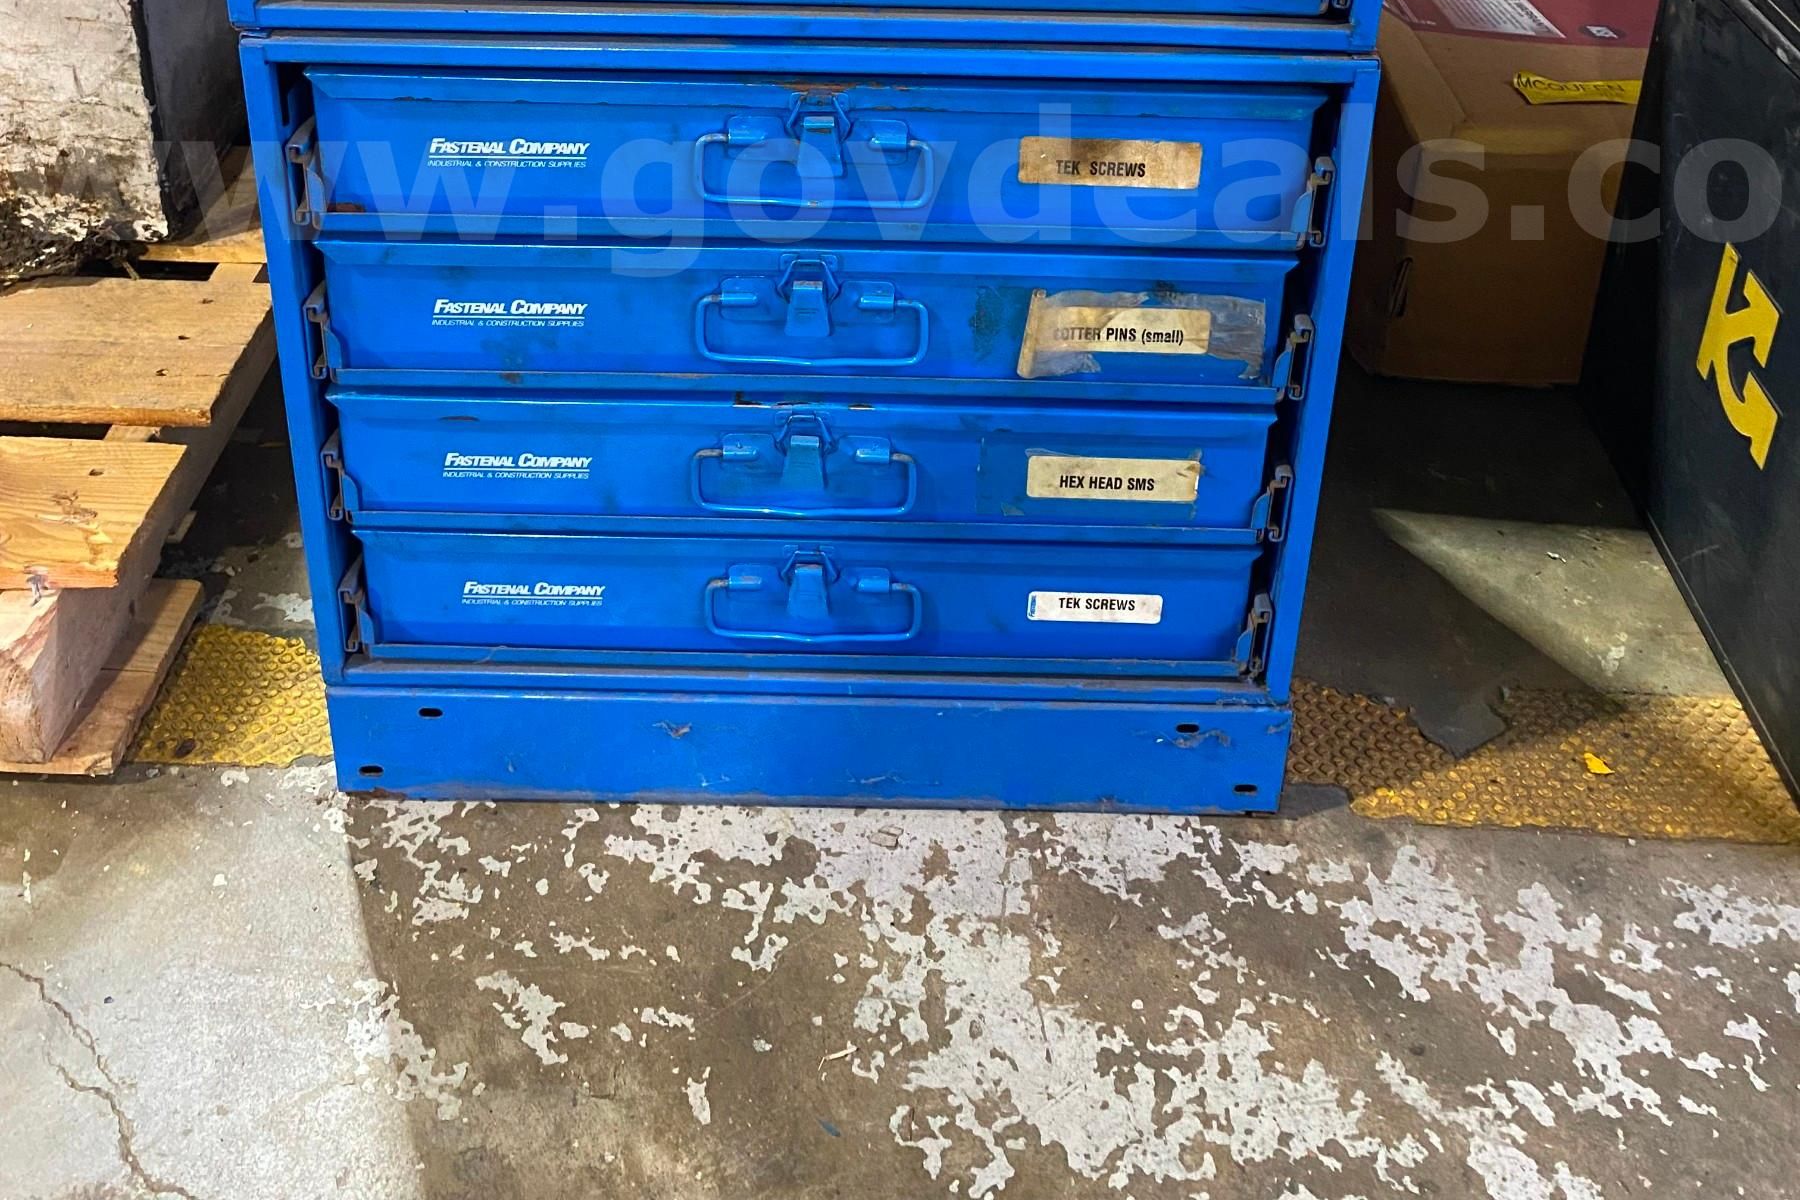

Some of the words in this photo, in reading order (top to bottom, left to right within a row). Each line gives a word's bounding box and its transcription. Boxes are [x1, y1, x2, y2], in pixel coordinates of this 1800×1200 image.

[429, 138, 507, 154] FASTENAL
[508, 138, 590, 154] COMPANY
[1055, 160, 1080, 176] TEK
[1089, 161, 1146, 177] SCREWS
[433, 299, 508, 314] FASTENAL
[510, 300, 588, 315] COMPANY
[1106, 328, 1137, 342] PINS
[1141, 328, 1184, 346] (small)
[444, 453, 515, 467] FASTENAL
[518, 453, 593, 468] COMPANY
[1059, 475, 1085, 489] HEX
[1088, 476, 1123, 490] HEAD
[1127, 477, 1155, 491] SMS
[463, 582, 532, 596] FASTENAL
[534, 582, 606, 597] COMPANY
[1059, 597, 1081, 609] TEK
[1085, 598, 1136, 611] SCREWS
